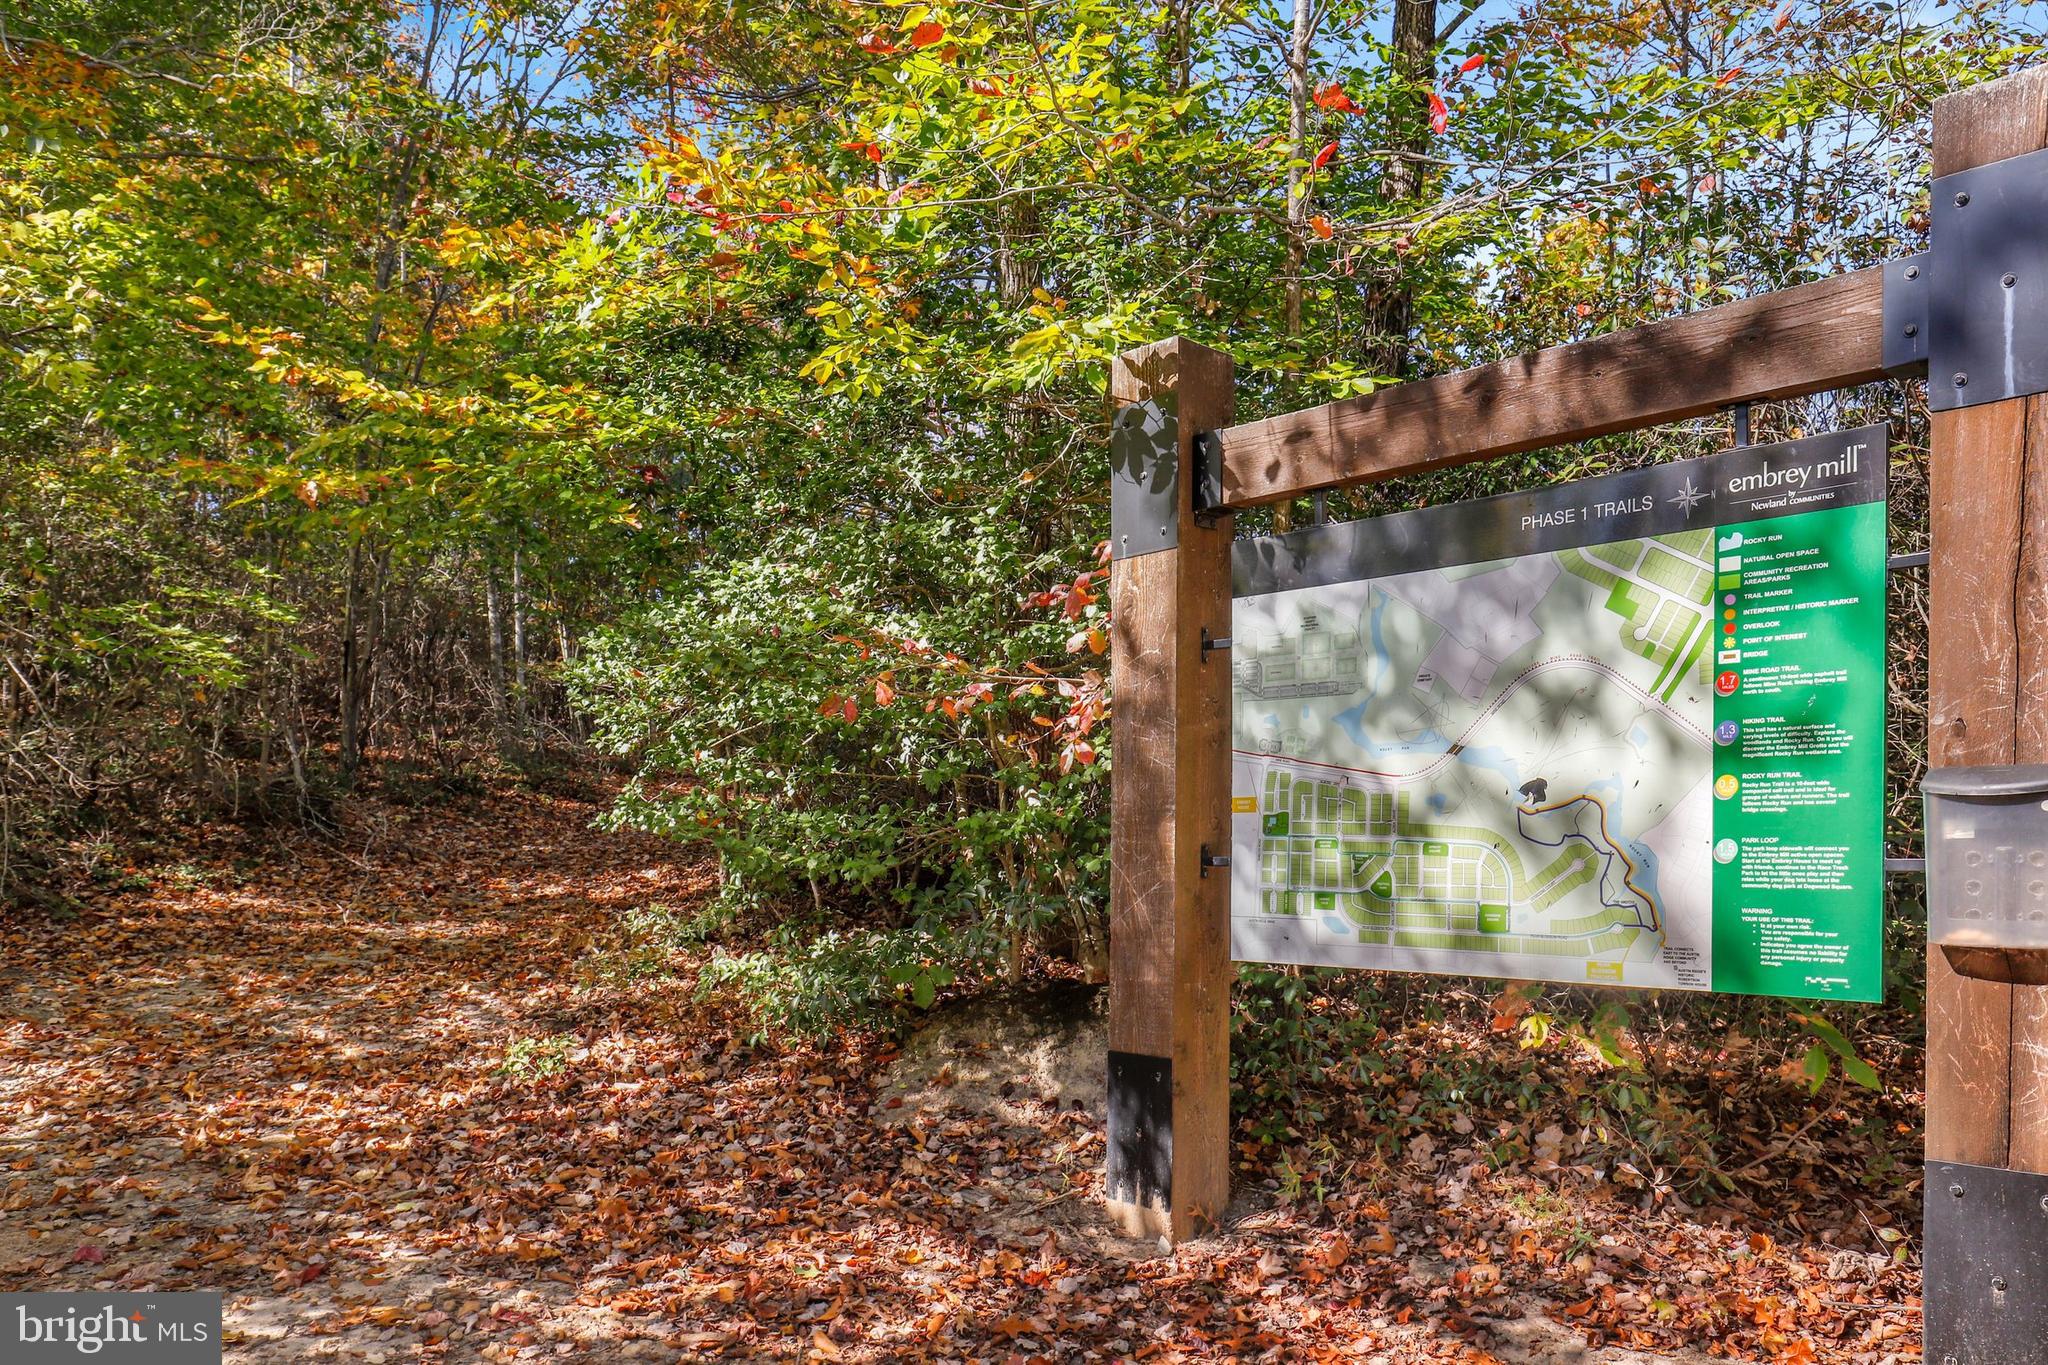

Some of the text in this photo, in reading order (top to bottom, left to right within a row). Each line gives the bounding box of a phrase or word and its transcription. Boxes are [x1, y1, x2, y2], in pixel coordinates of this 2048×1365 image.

[1729, 462, 1811, 493] embrey
[1788, 490, 1797, 499] by
[1751, 491, 1835, 512] Newland COMMUNITIES
[1521, 496, 1653, 531] PHASE 1 TRAILS
[1743, 534, 1783, 545] ROCKY RUN
[1743, 548, 1819, 563] NATURAL OPEN SPACE
[1743, 562, 1829, 578] COMMUNITY RECREATION
[1743, 574, 1791, 585] AREAS/PARKS
[1764, 588, 1793, 597] MARKER
[1743, 605, 1790, 615] INTERPRETIVE
[1795, 601, 1828, 609] HISTORIC
[1828, 597, 1859, 606] MARKER
[1743, 621, 1780, 630] OVERLOOK
[1774, 632, 1808, 641] INTEREST
[1743, 650, 1768, 658] BRIDGE
[1720, 675, 1737, 686] 1.7
[1720, 725, 1736, 735] 1.3
